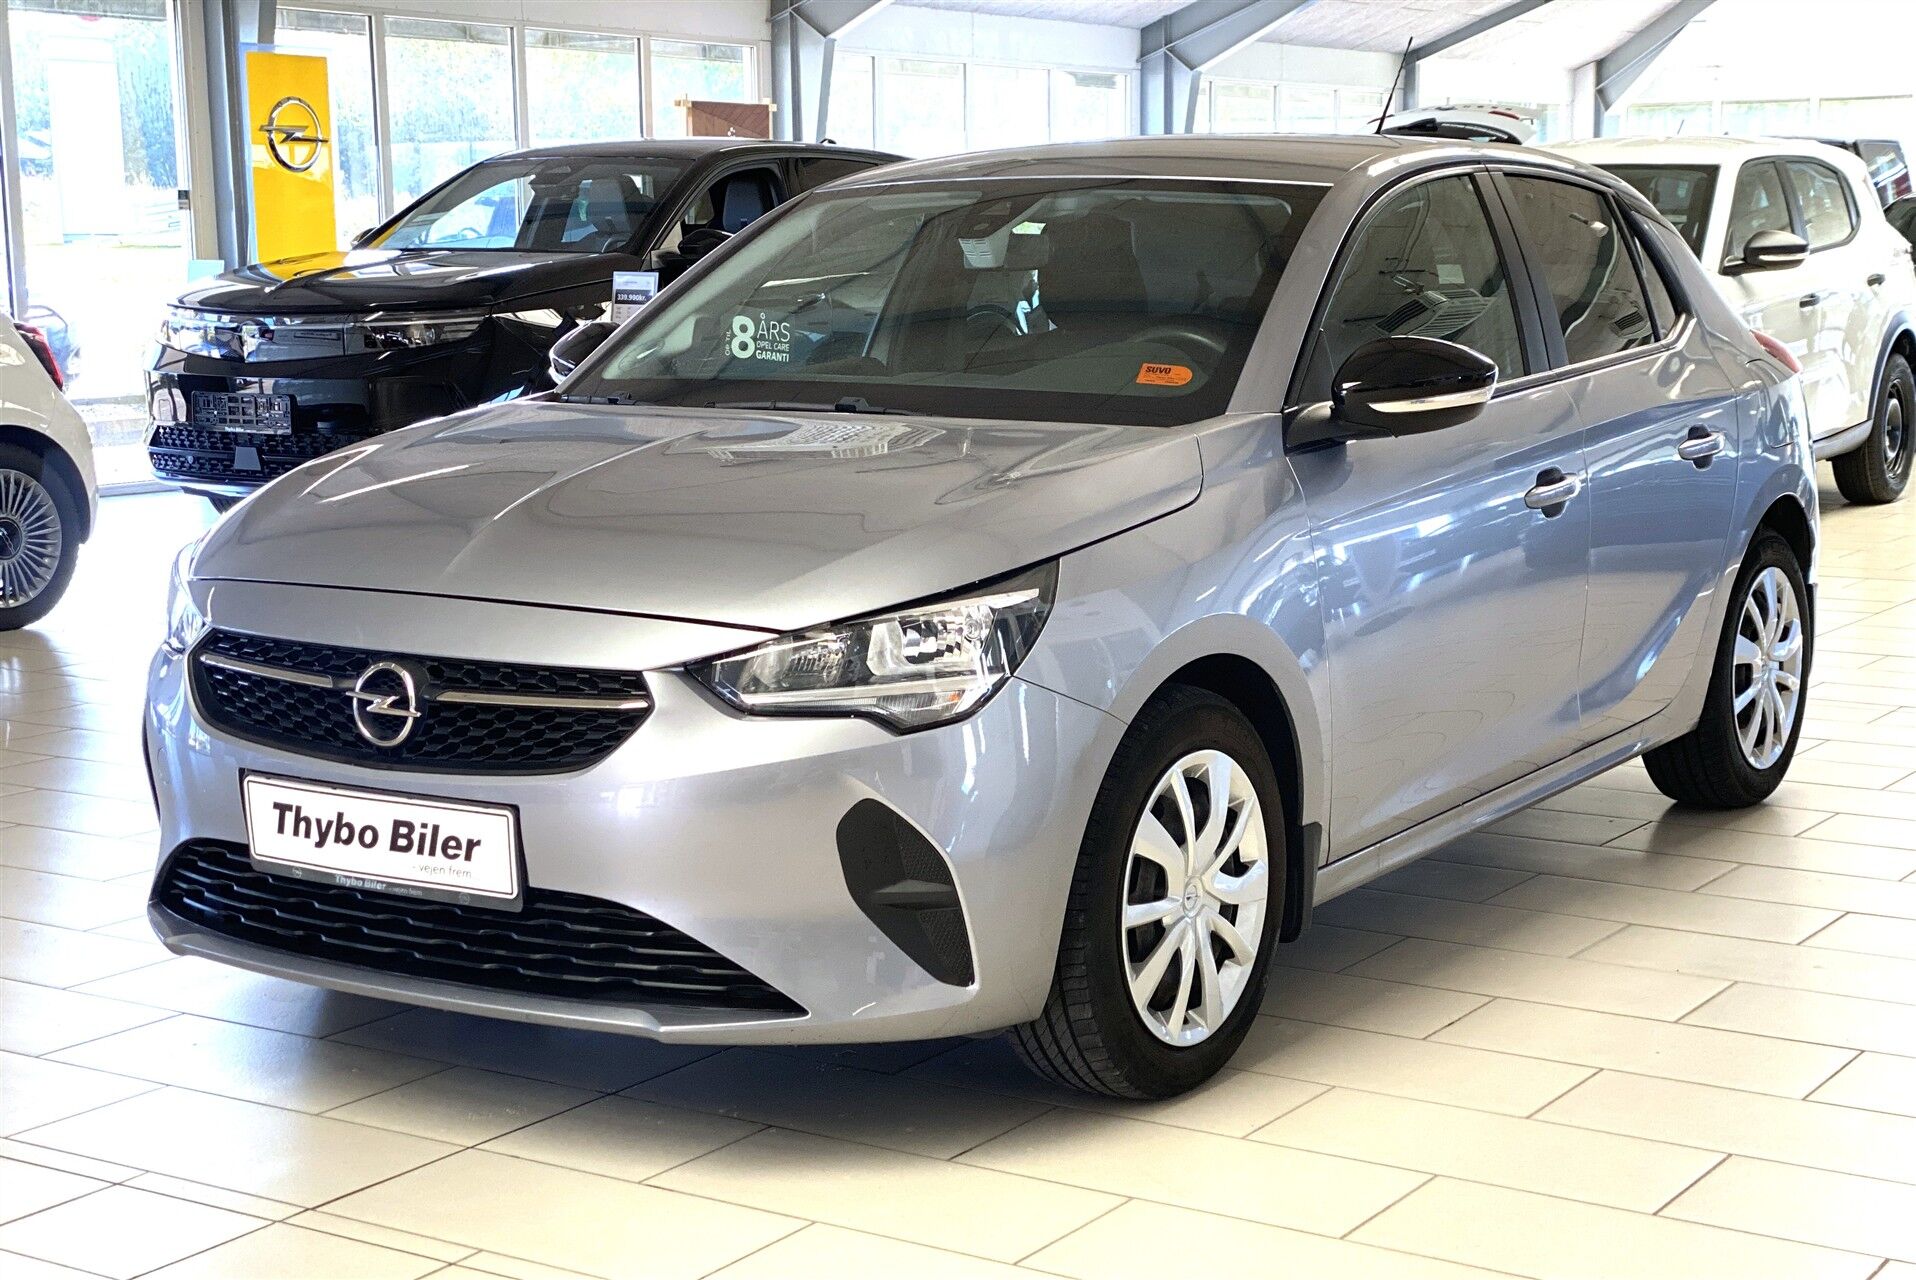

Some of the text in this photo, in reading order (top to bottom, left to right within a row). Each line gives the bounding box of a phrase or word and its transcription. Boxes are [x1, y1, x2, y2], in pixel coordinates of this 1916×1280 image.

[756, 312, 790, 342] ÅRS
[731, 315, 755, 359] 8
[756, 341, 790, 352] OPEL CARE
[755, 350, 790, 362] GARANTI
[272, 801, 482, 862] Thybo Biler
[418, 863, 446, 876] vejen
[448, 865, 472, 879] frem
[335, 874, 387, 890] Thybo Biler
